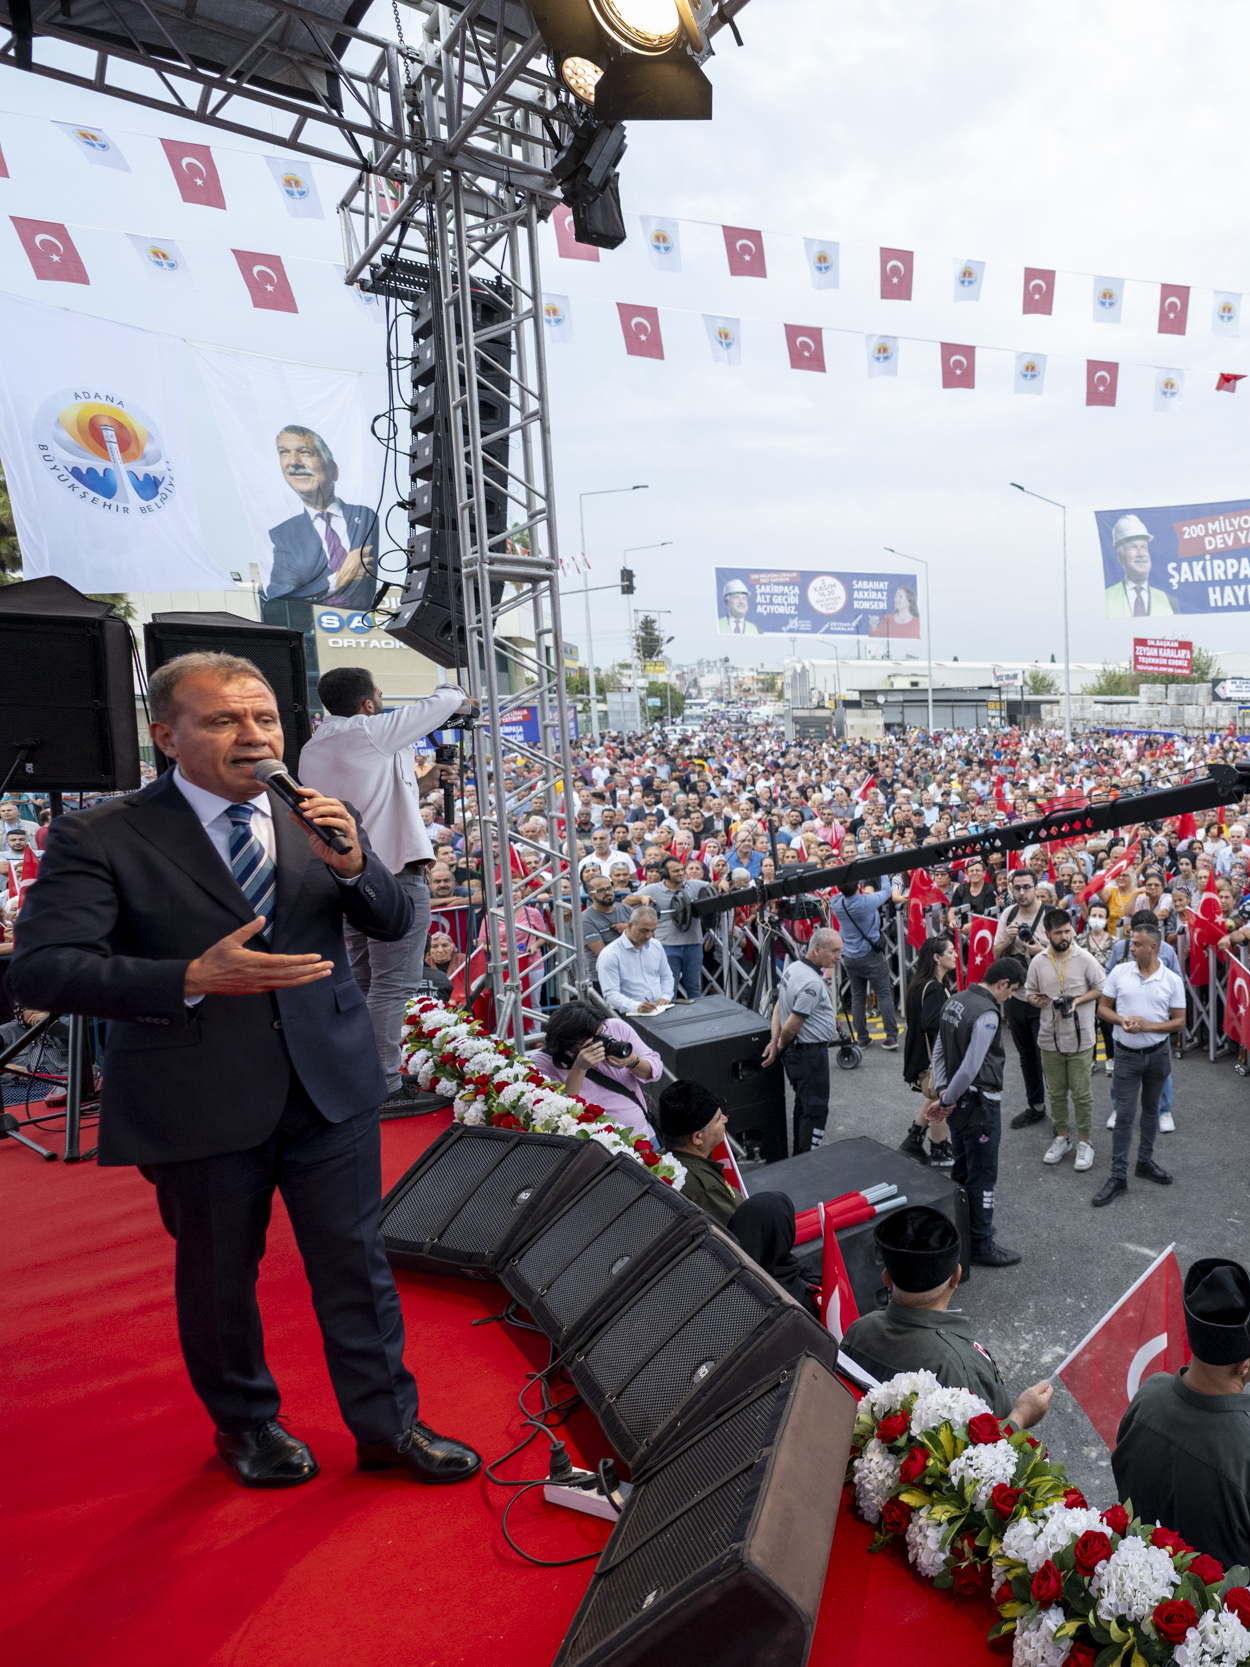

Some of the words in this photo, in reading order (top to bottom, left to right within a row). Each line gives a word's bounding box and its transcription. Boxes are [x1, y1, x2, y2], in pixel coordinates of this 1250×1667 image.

[74, 391, 125, 408] ADANA
[1182, 524, 1205, 540] 200
[1204, 534, 1234, 550] DEV
[755, 583, 800, 596] ŞAKİRPAŞA
[814, 583, 837, 592] KASIM
[852, 580, 889, 590] SABAHAT
[756, 594, 770, 604] ALT
[772, 593, 799, 606] GEÇİDİ
[853, 589, 888, 600] AKKİRAZ
[756, 604, 798, 616] AÇIYORUZ.
[853, 598, 888, 610] KONSERİ
[1135, 645, 1158, 657] ZEYDAN
